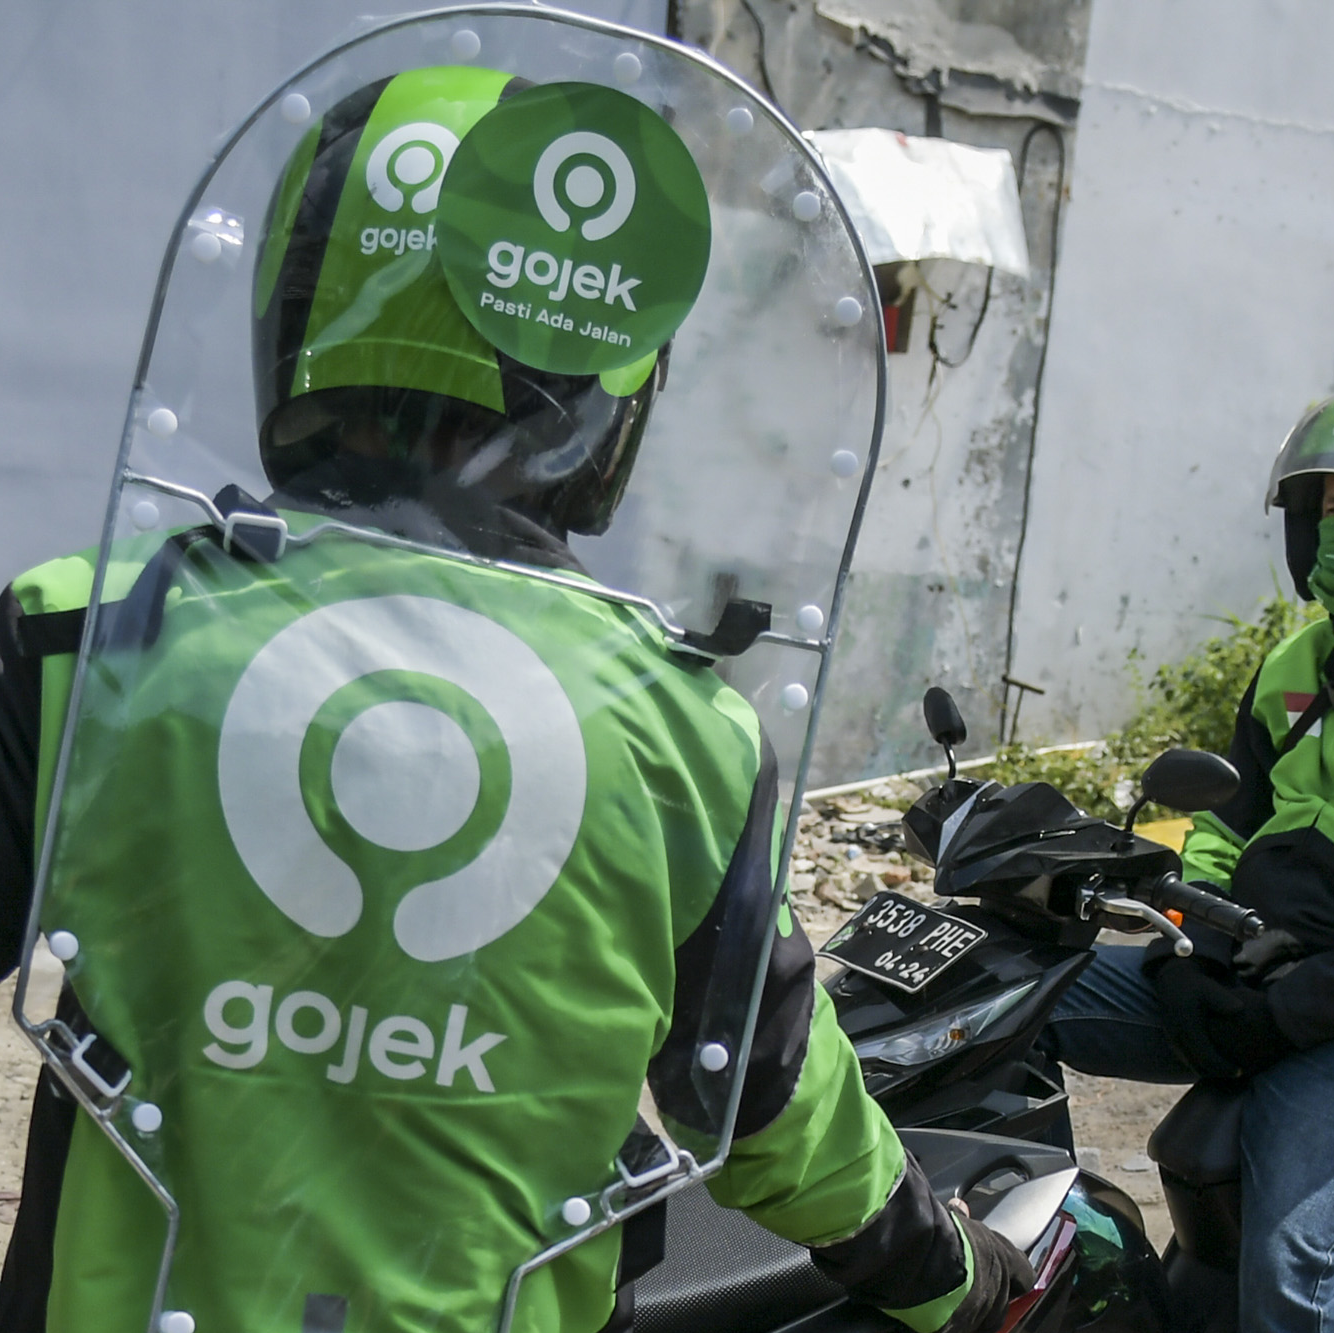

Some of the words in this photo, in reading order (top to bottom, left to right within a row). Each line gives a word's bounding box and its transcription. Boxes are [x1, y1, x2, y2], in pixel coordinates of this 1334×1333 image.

[486, 241, 643, 312] gojek
[480, 292, 532, 319] Pasti
[535, 309, 574, 332] Ada
[579, 321, 631, 348] Jalan
[867, 899, 926, 938] 3538
[919, 922, 976, 958] PHE
[202, 979, 509, 1094] gojek
